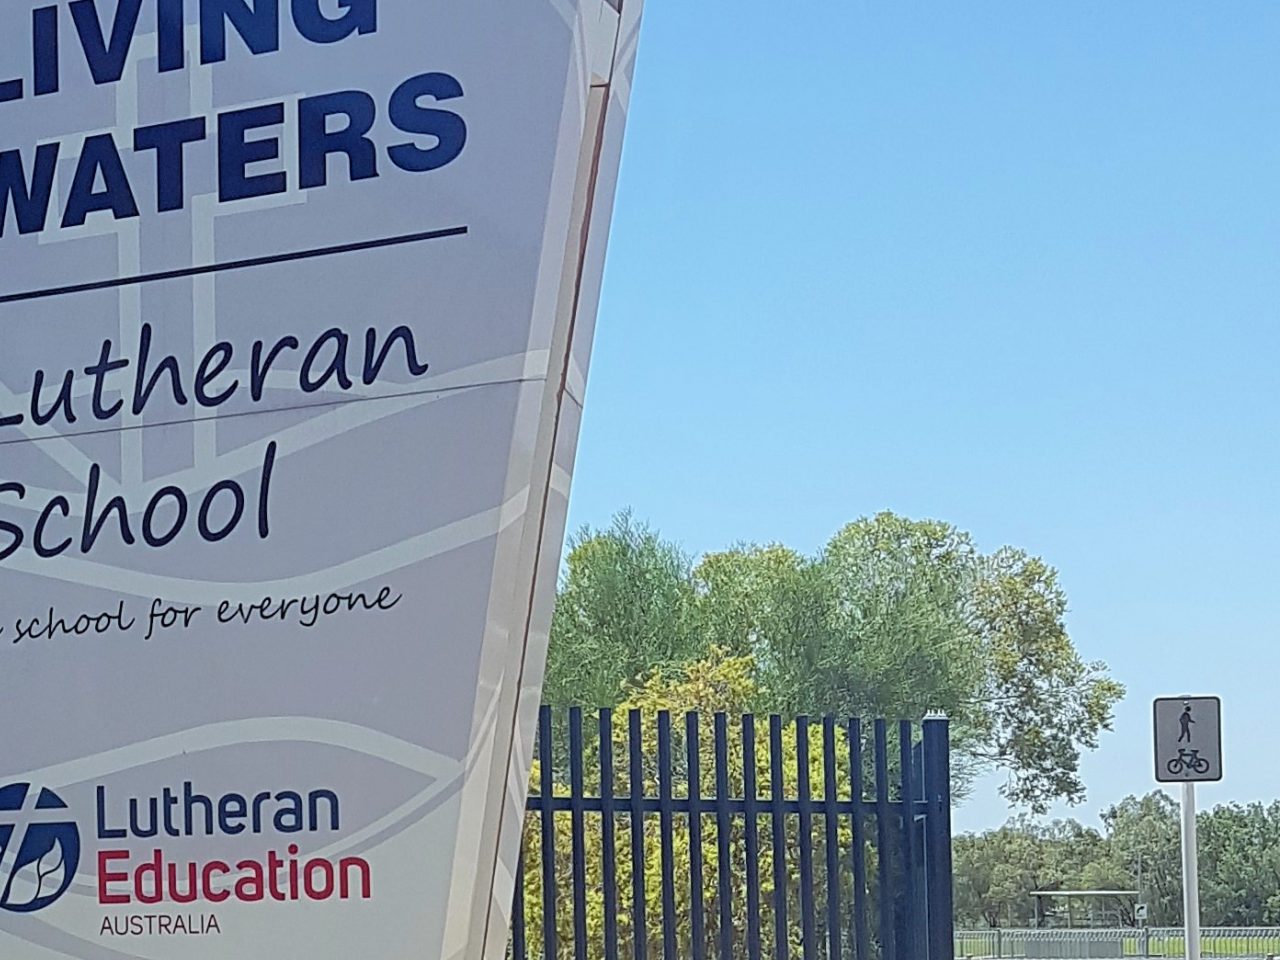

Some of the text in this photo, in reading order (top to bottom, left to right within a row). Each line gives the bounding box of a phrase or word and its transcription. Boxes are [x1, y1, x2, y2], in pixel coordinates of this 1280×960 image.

[13, 600, 136, 644] school
[144, 598, 202, 640] for
[217, 586, 402, 627] everyone
[96, 780, 340, 839] Lutheran
[96, 843, 372, 905] Education
[99, 913, 221, 936] AUSTRALIA
